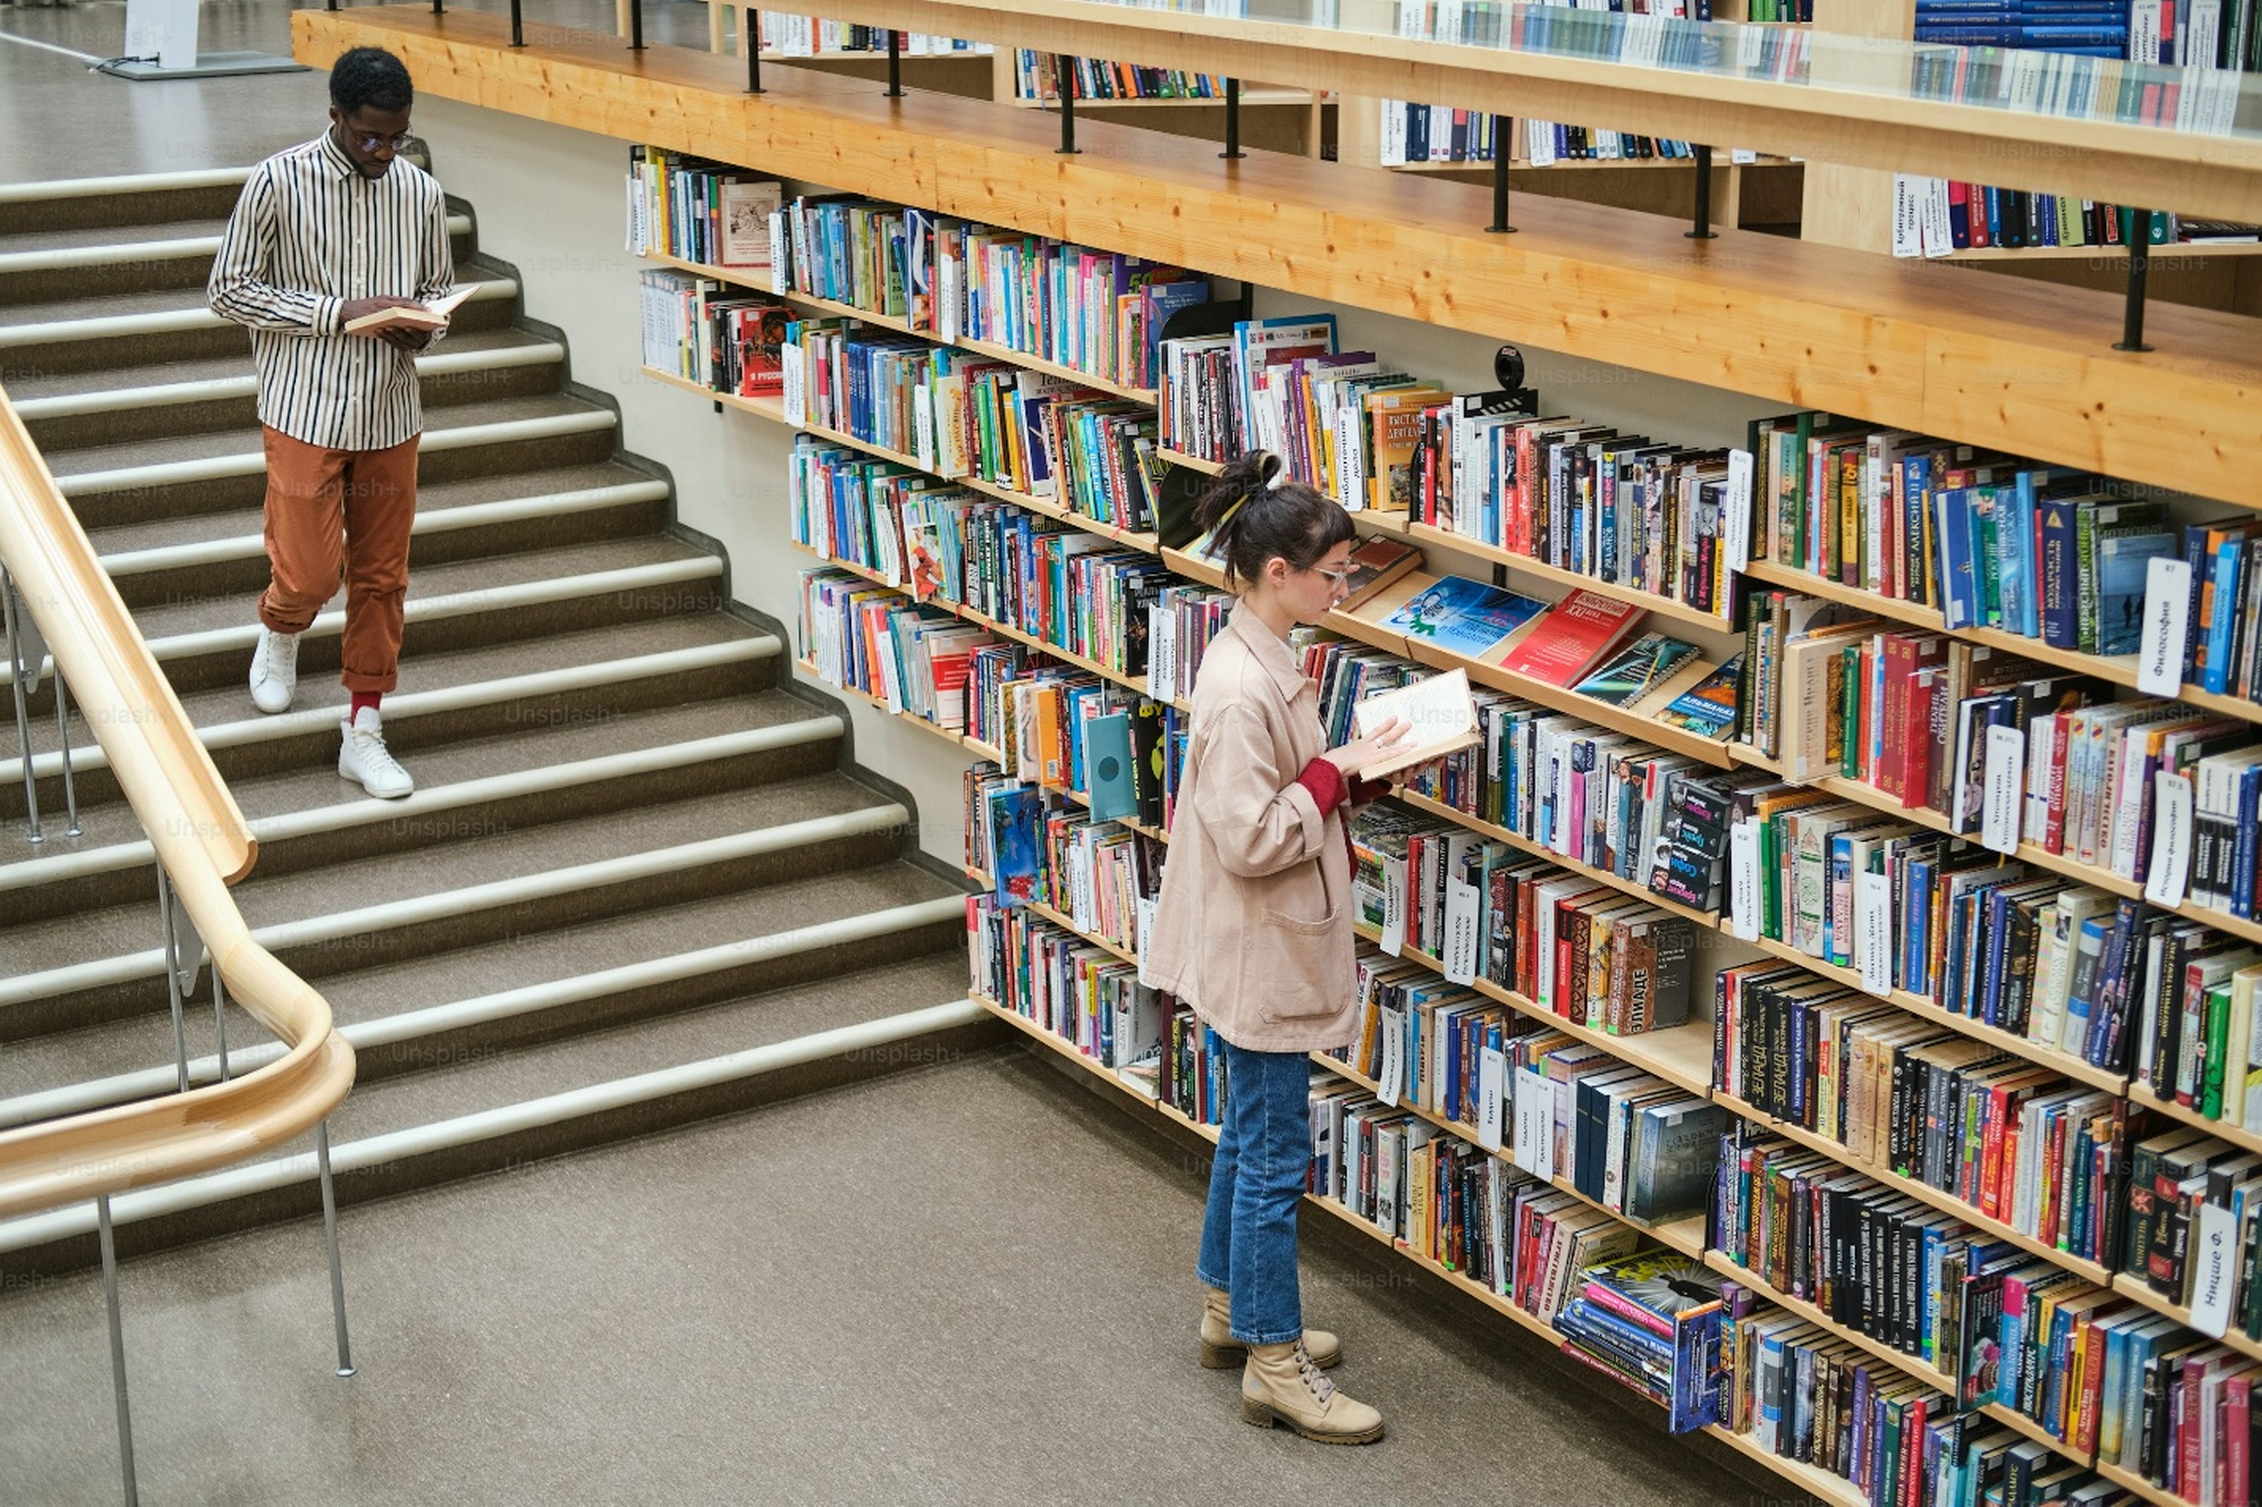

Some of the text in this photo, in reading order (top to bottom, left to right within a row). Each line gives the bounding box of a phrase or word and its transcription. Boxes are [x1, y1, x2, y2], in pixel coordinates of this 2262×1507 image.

[1908, 496, 1920, 551] АЛЕКСИЙ
[2046, 539, 2055, 610] МУДРОСТЬ
[2153, 600, 2172, 677] Философия
[1631, 969, 1648, 1033] ЭЛИАДЕ
[1752, 1044, 1767, 1098] ЗЕЛАНД
[1773, 1053, 1788, 1106] ЗЕЛАНД
[2203, 1229, 2224, 1308] Ницше Ф.
